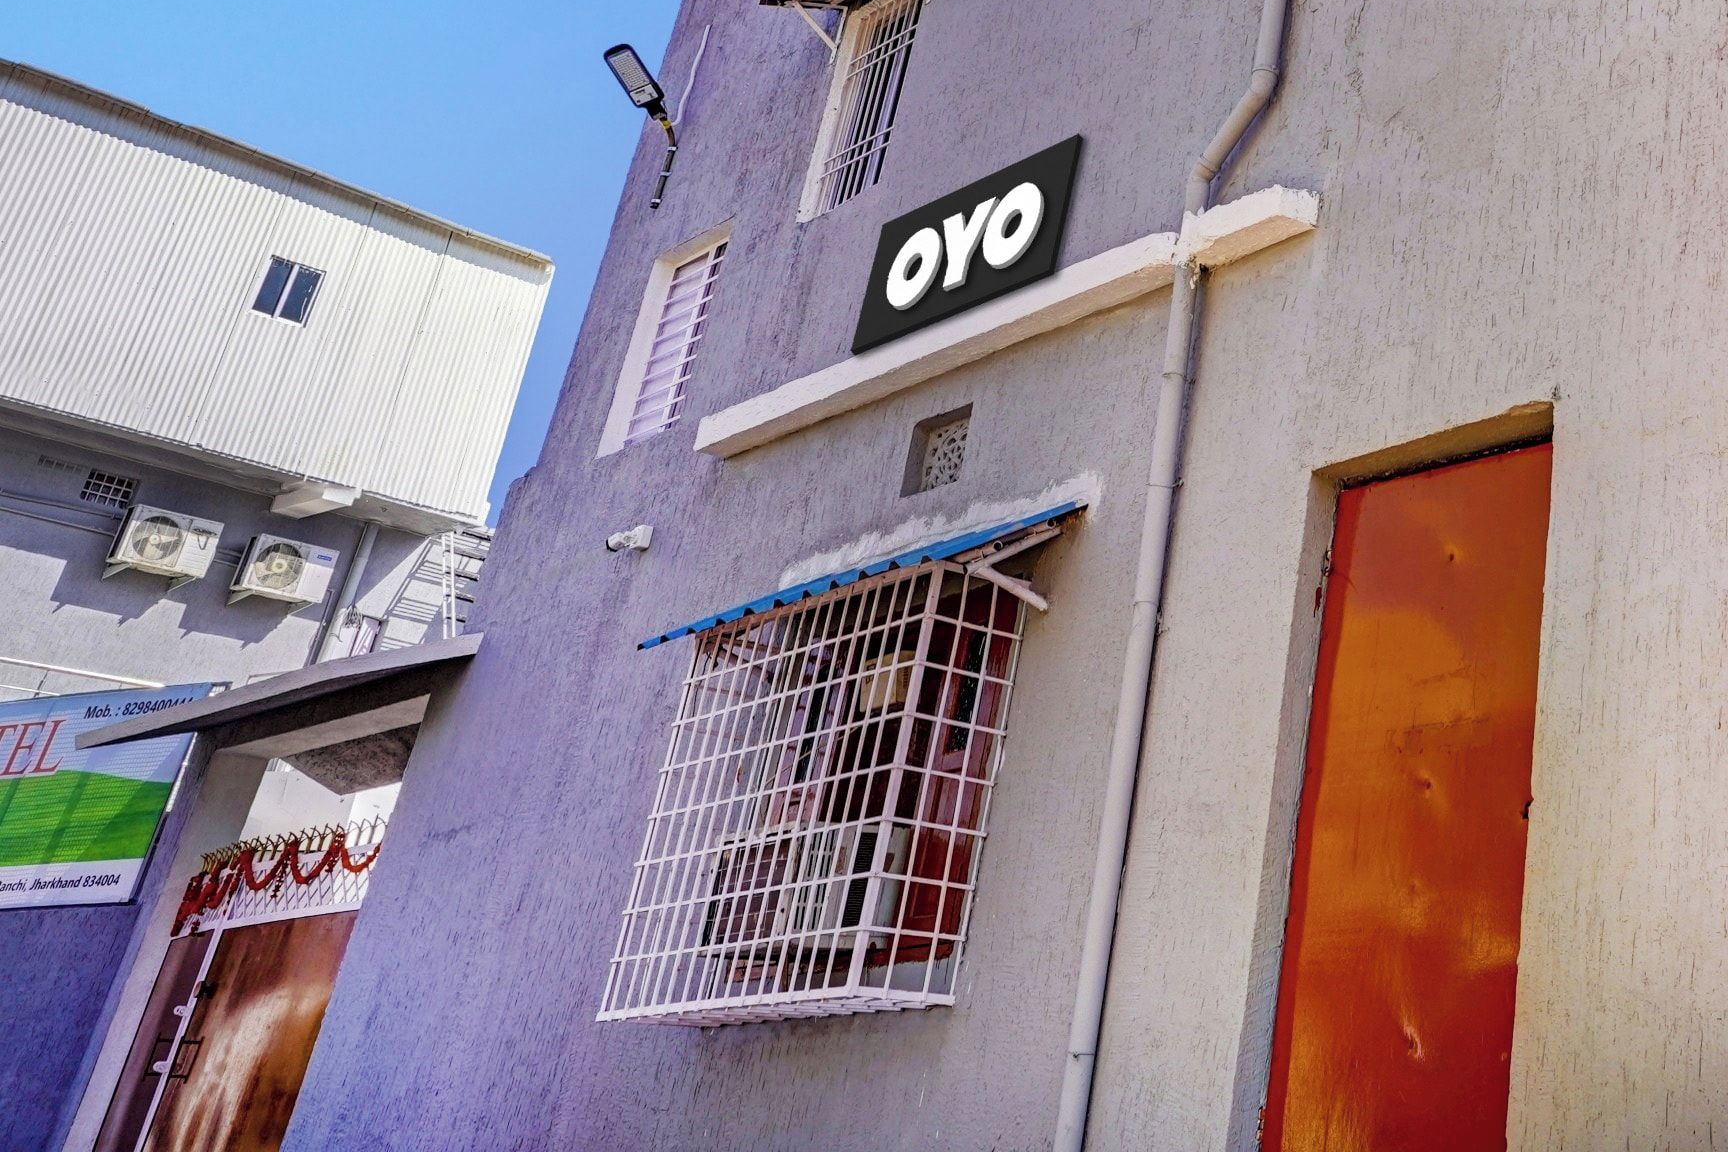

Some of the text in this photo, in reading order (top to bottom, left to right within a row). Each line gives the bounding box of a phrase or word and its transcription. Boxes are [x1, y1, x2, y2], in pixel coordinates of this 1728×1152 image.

[886, 182, 1044, 311] OYO
[83, 704, 112, 720] Mob.
[0, 874, 121, 893] anchi, Jharkhand 834004
